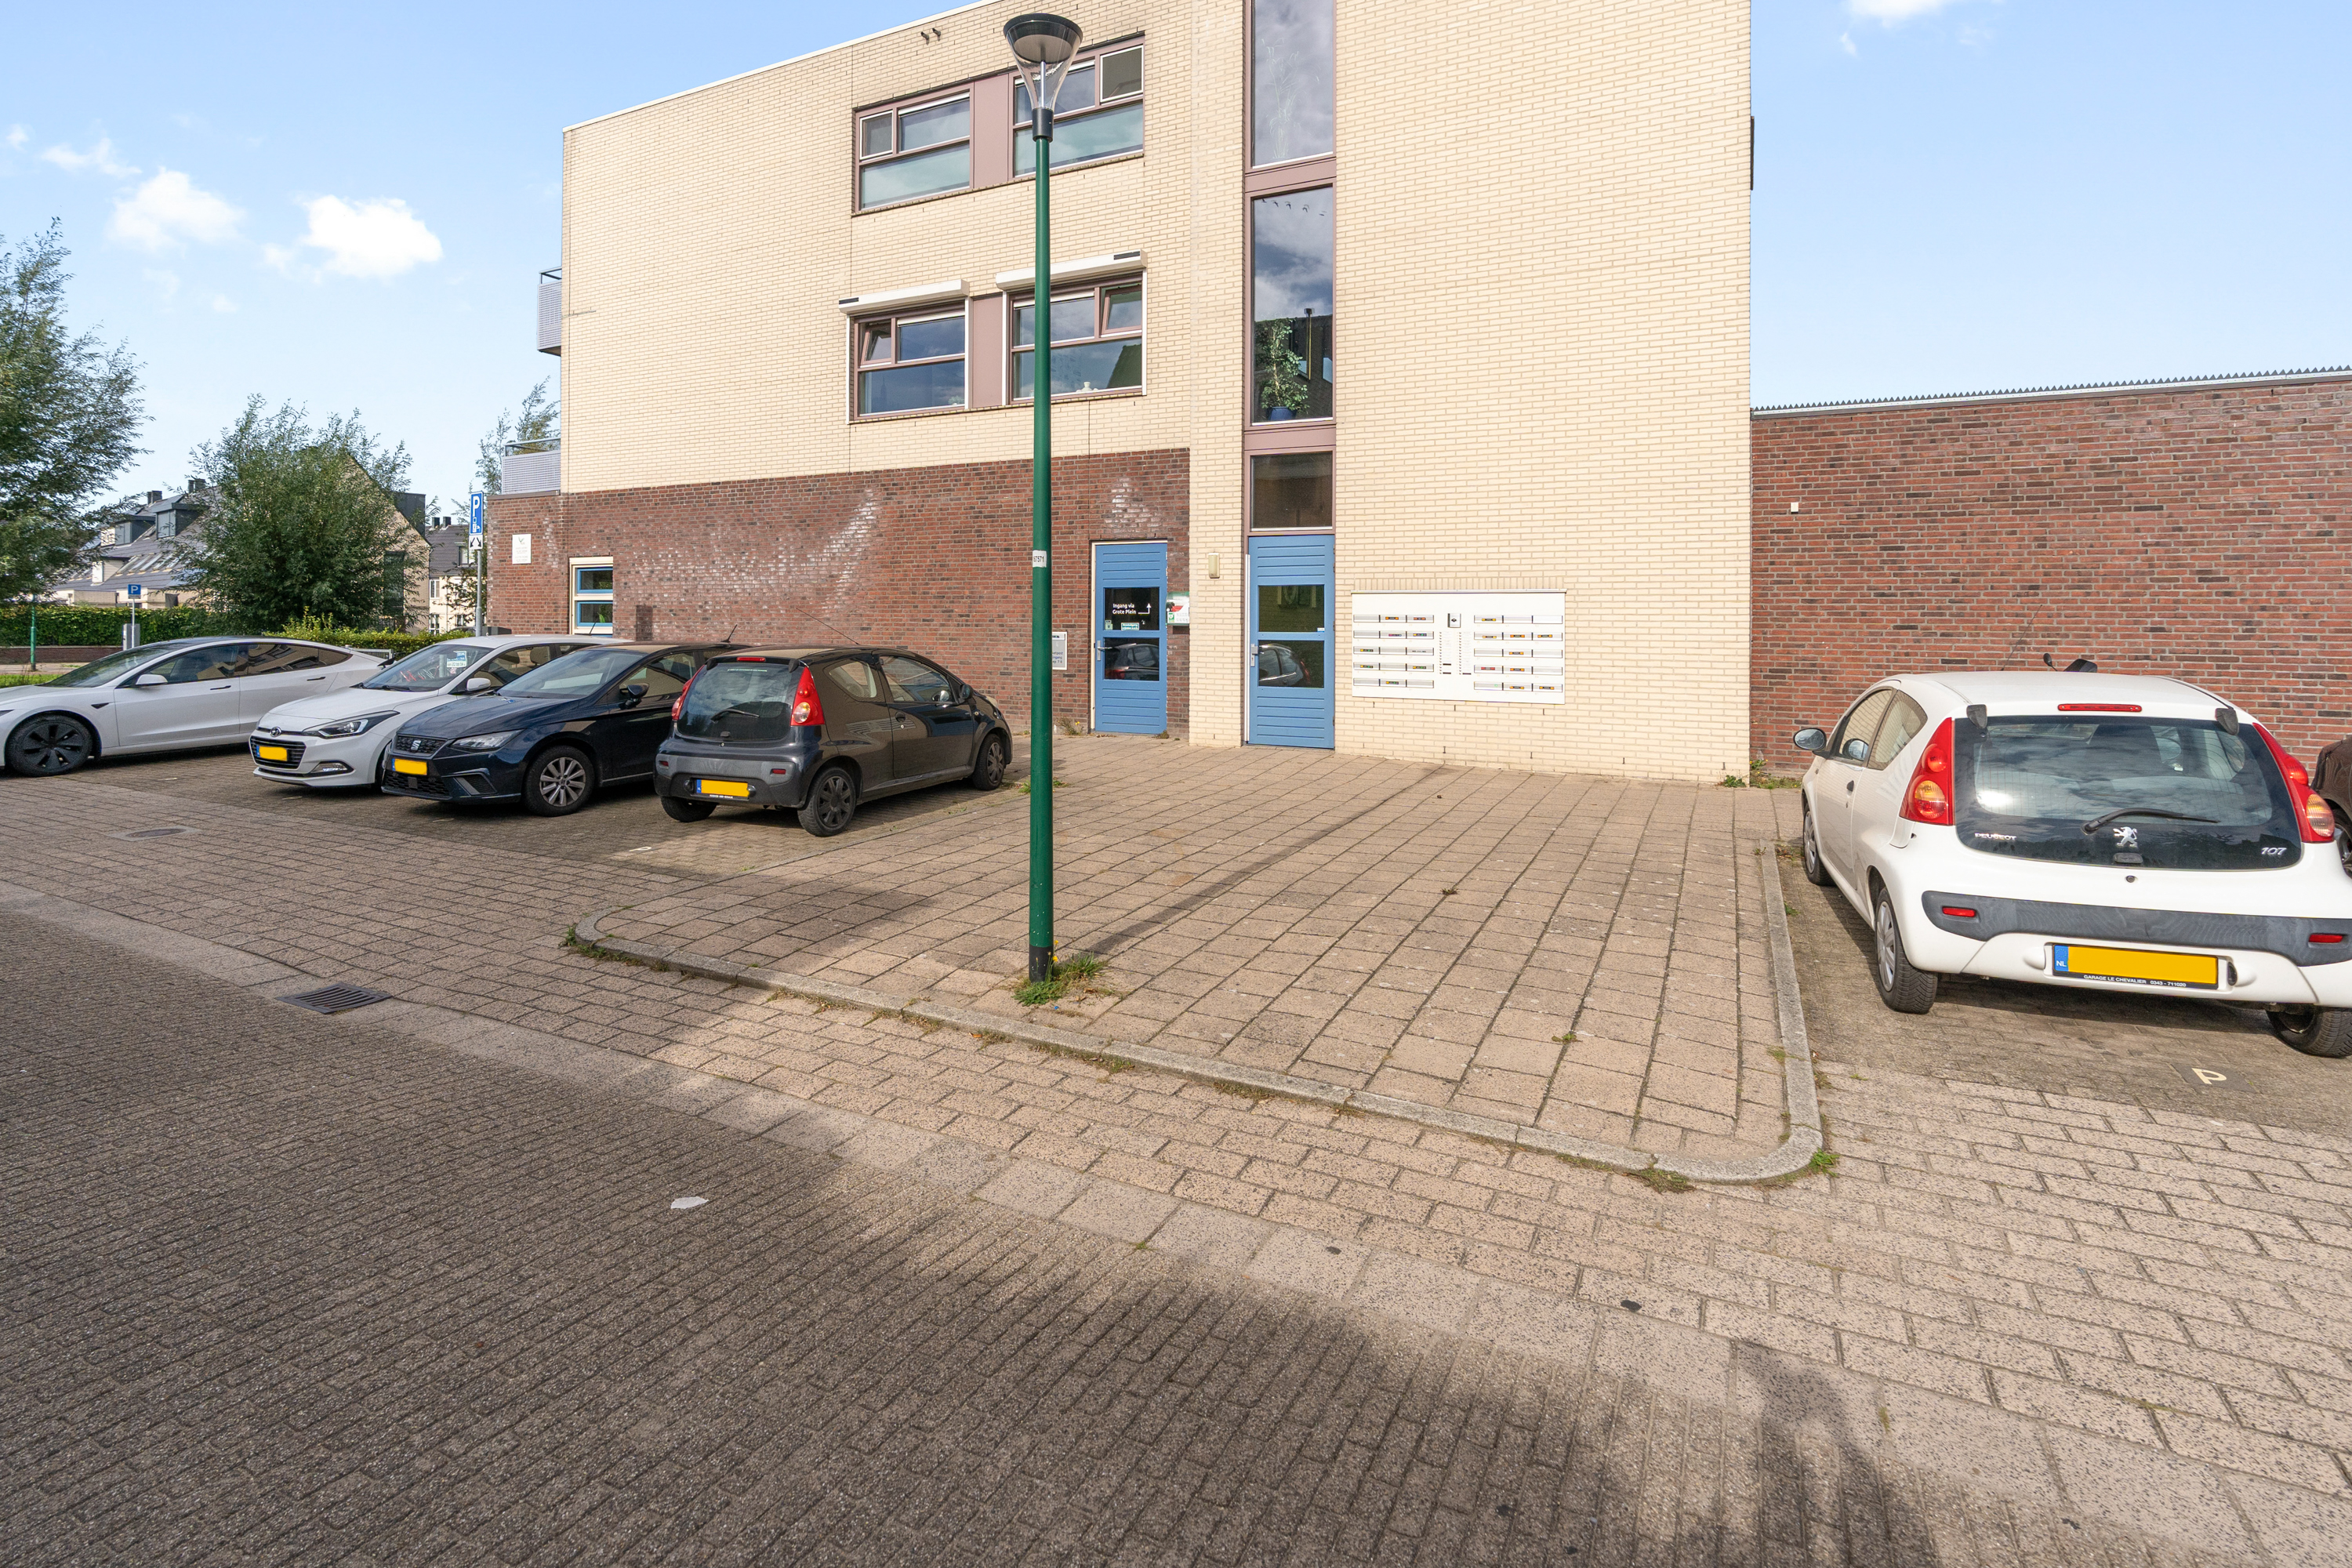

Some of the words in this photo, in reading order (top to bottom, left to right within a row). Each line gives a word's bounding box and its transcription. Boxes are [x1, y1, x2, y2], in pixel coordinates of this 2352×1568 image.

[472, 495, 481, 517] P
[130, 585, 139, 594] P
[2261, 847, 2287, 855] 107
[2191, 1068, 2227, 1085] P
